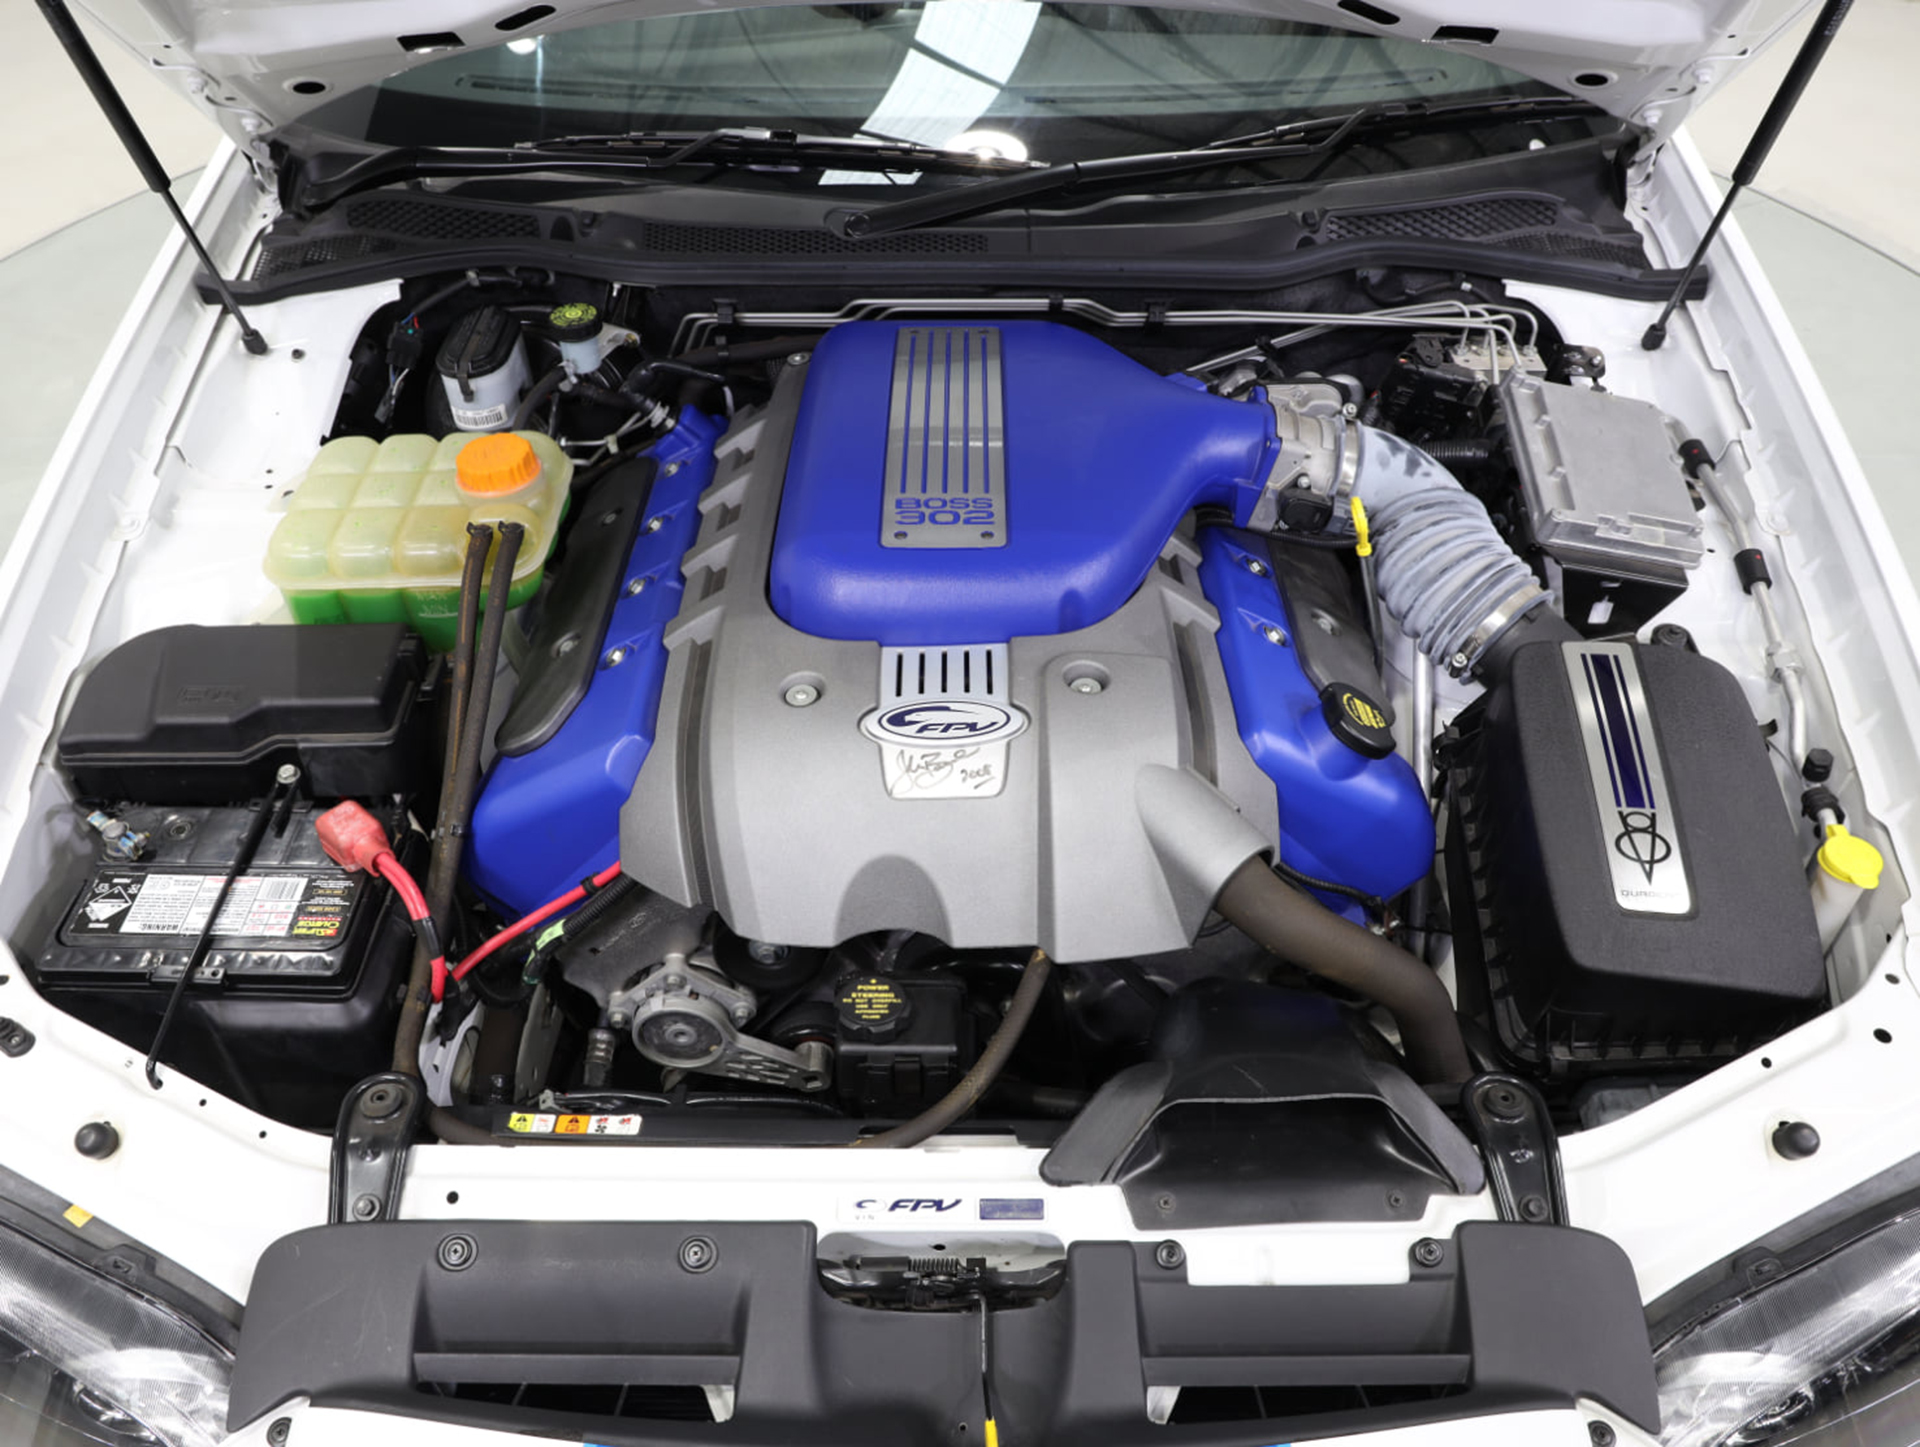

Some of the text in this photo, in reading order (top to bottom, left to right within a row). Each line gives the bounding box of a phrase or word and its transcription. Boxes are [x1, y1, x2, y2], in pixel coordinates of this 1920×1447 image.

[894, 497, 994, 510] BOSS
[894, 510, 996, 526] 302
[914, 721, 1000, 734] FPV
[888, 1198, 963, 1212] FPV
